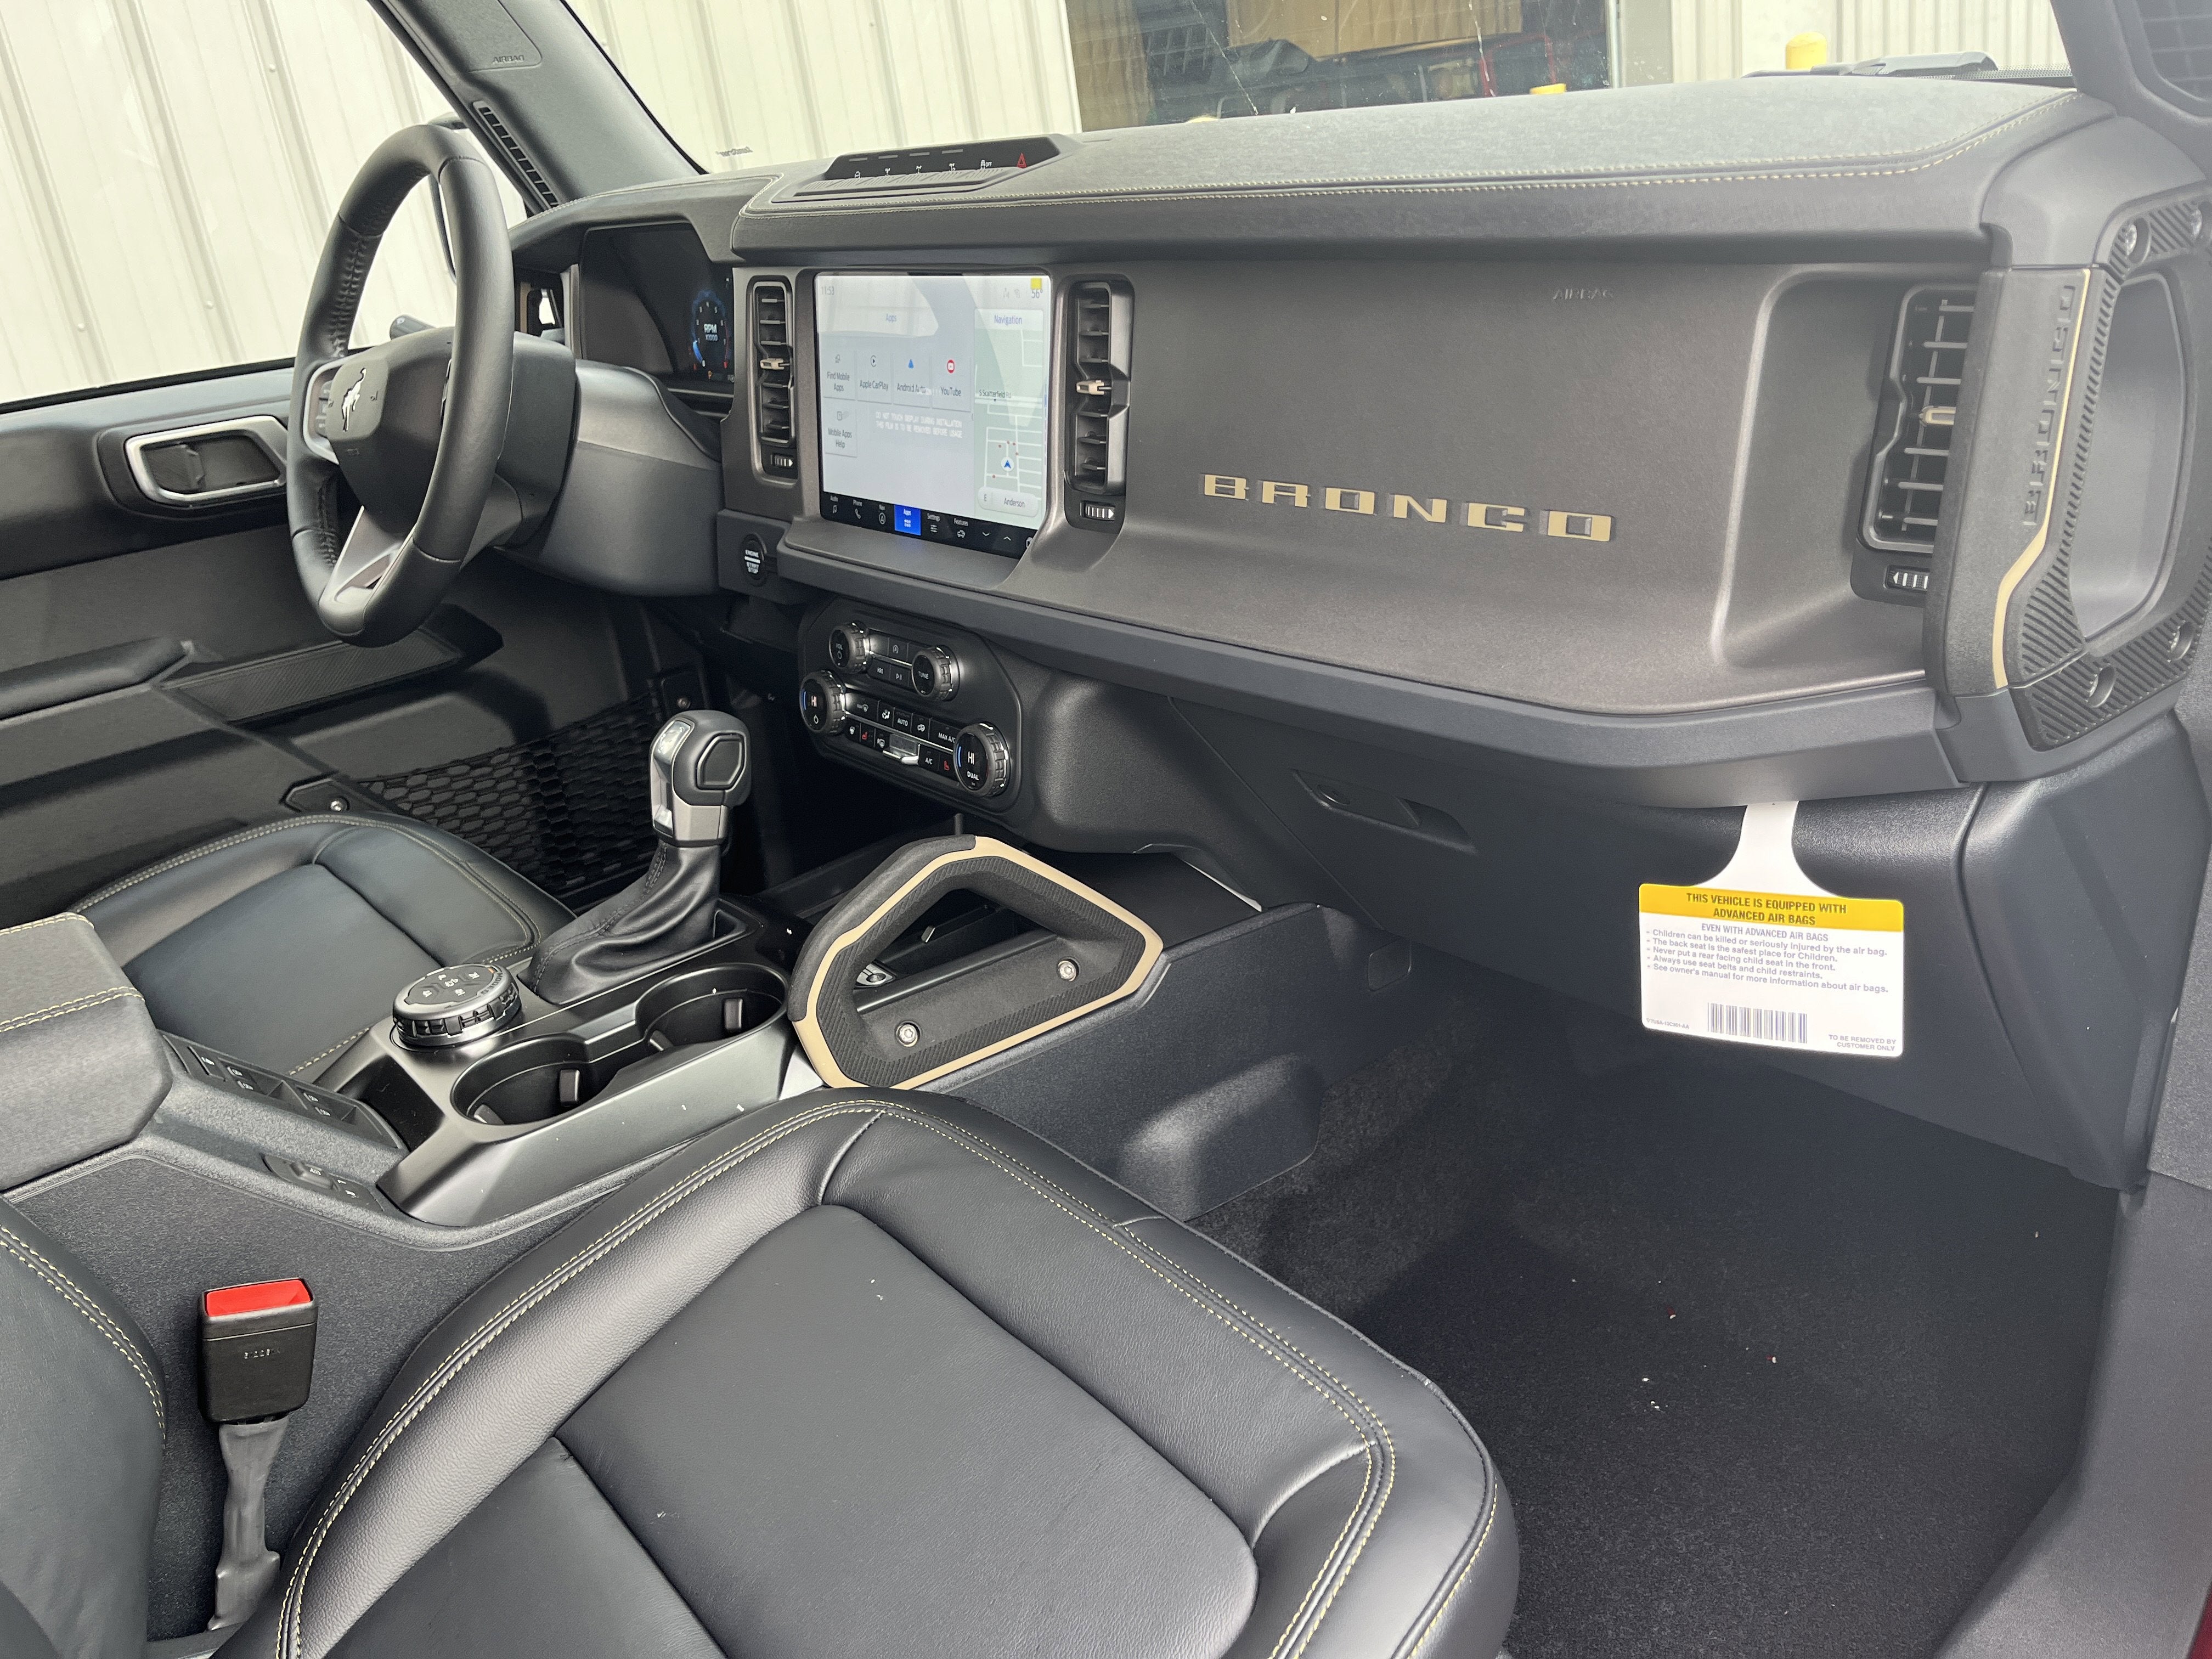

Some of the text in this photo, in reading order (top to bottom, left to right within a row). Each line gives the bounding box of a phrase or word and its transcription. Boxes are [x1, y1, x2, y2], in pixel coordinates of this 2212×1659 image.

[821, 286, 834, 295] 11:53
[885, 313, 897, 323] Apps
[994, 314, 1023, 325] Navigation
[703, 324, 718, 334] RPM
[827, 371, 850, 381] Find Mobile
[833, 383, 844, 392] Apps
[860, 380, 888, 392] Apple CarPlay
[897, 383, 915, 392] Android
[940, 386, 962, 397] YouTube
[982, 390, 1006, 398] Scatterfield
[828, 428, 852, 438] Mobile Apps
[836, 439, 845, 448] Help
[1004, 498, 1025, 508] Anderson
[1203, 473, 1612, 541] BRONCO
[927, 513, 940, 522] Settings
[954, 518, 968, 527] Features
[918, 671, 929, 680] TUNE
[897, 718, 909, 727] AUTO
[938, 732, 947, 741] MAX
[967, 751, 975, 765] HI
[967, 771, 979, 781] DUAL
[1686, 893, 1847, 914] THIS VEHICLE IS EQUIPPED WITH
[1713, 908, 1816, 926] ADVANCED AIR BAGS
[1701, 923, 1829, 942] EVEN WITH ADVANCED AIR BAGS
[1652, 929, 1685, 939] Children
[1716, 935, 1737, 944] killed
[1750, 940, 1788, 950] seriously
[1791, 942, 1820, 951] injured
[1823, 945, 1834, 953] by
[1867, 947, 1887, 957] bag.
[1669, 939, 1688, 947] back
[1798, 952, 1838, 962] Children.
[1653, 946, 1675, 955] Never
[1716, 953, 1741, 964] facing
[1743, 956, 1763, 964] child
[1812, 962, 1836, 970] front.
[1653, 955, 1681, 965] Always
[1717, 962, 1737, 971] belts
[1779, 969, 1822, 979] restraints.
[1654, 963, 1668, 971] See
[1669, 966, 1700, 975] owner's
[1702, 969, 1730, 979] manual
[1770, 977, 1819, 988] information
[1821, 981, 1847, 990] about
[1863, 984, 1888, 994] bags.
[1837, 1042, 1875, 1050] CUSTOMER
